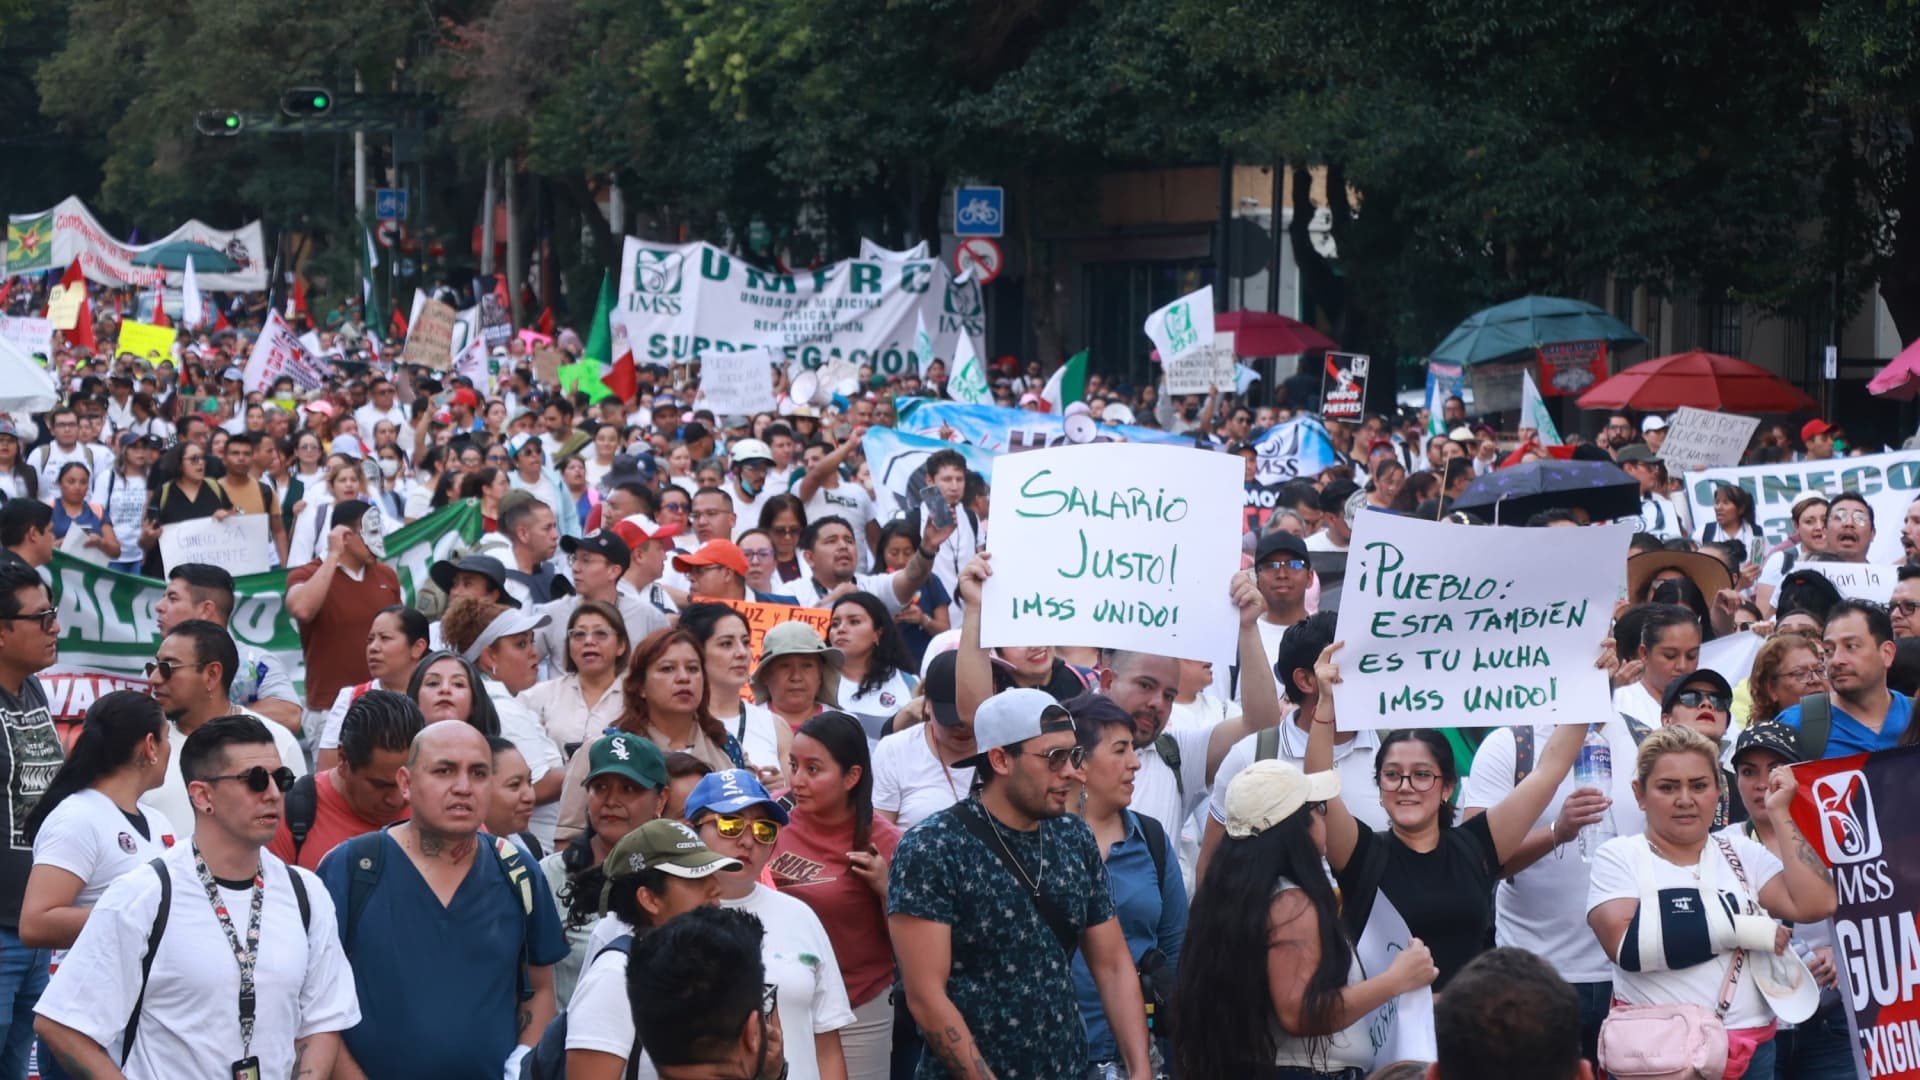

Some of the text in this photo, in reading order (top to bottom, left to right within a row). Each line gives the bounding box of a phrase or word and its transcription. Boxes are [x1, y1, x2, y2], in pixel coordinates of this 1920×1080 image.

[629, 293, 682, 316] IMSS
[741, 292, 791, 308] UNIDAD
[815, 297, 882, 310] MEDICINA
[939, 315, 983, 337] IMSS
[1243, 488, 1279, 507] MO
[1058, 528, 1178, 592] JUSTO!
[1359, 541, 1515, 602] ¡PUEBLO:
[1864, 566, 1882, 588] la
[1012, 592, 1179, 637] IMSS UNIDO!
[1371, 611, 1454, 638] ESTA
[1359, 645, 1550, 673] ES TU LUCHA
[1379, 676, 1557, 714] IMSS UNIDO!
[767, 851, 825, 880] NIKE
[1830, 859, 1895, 905] MSS
[1859, 1019, 1920, 1078] XIGI
